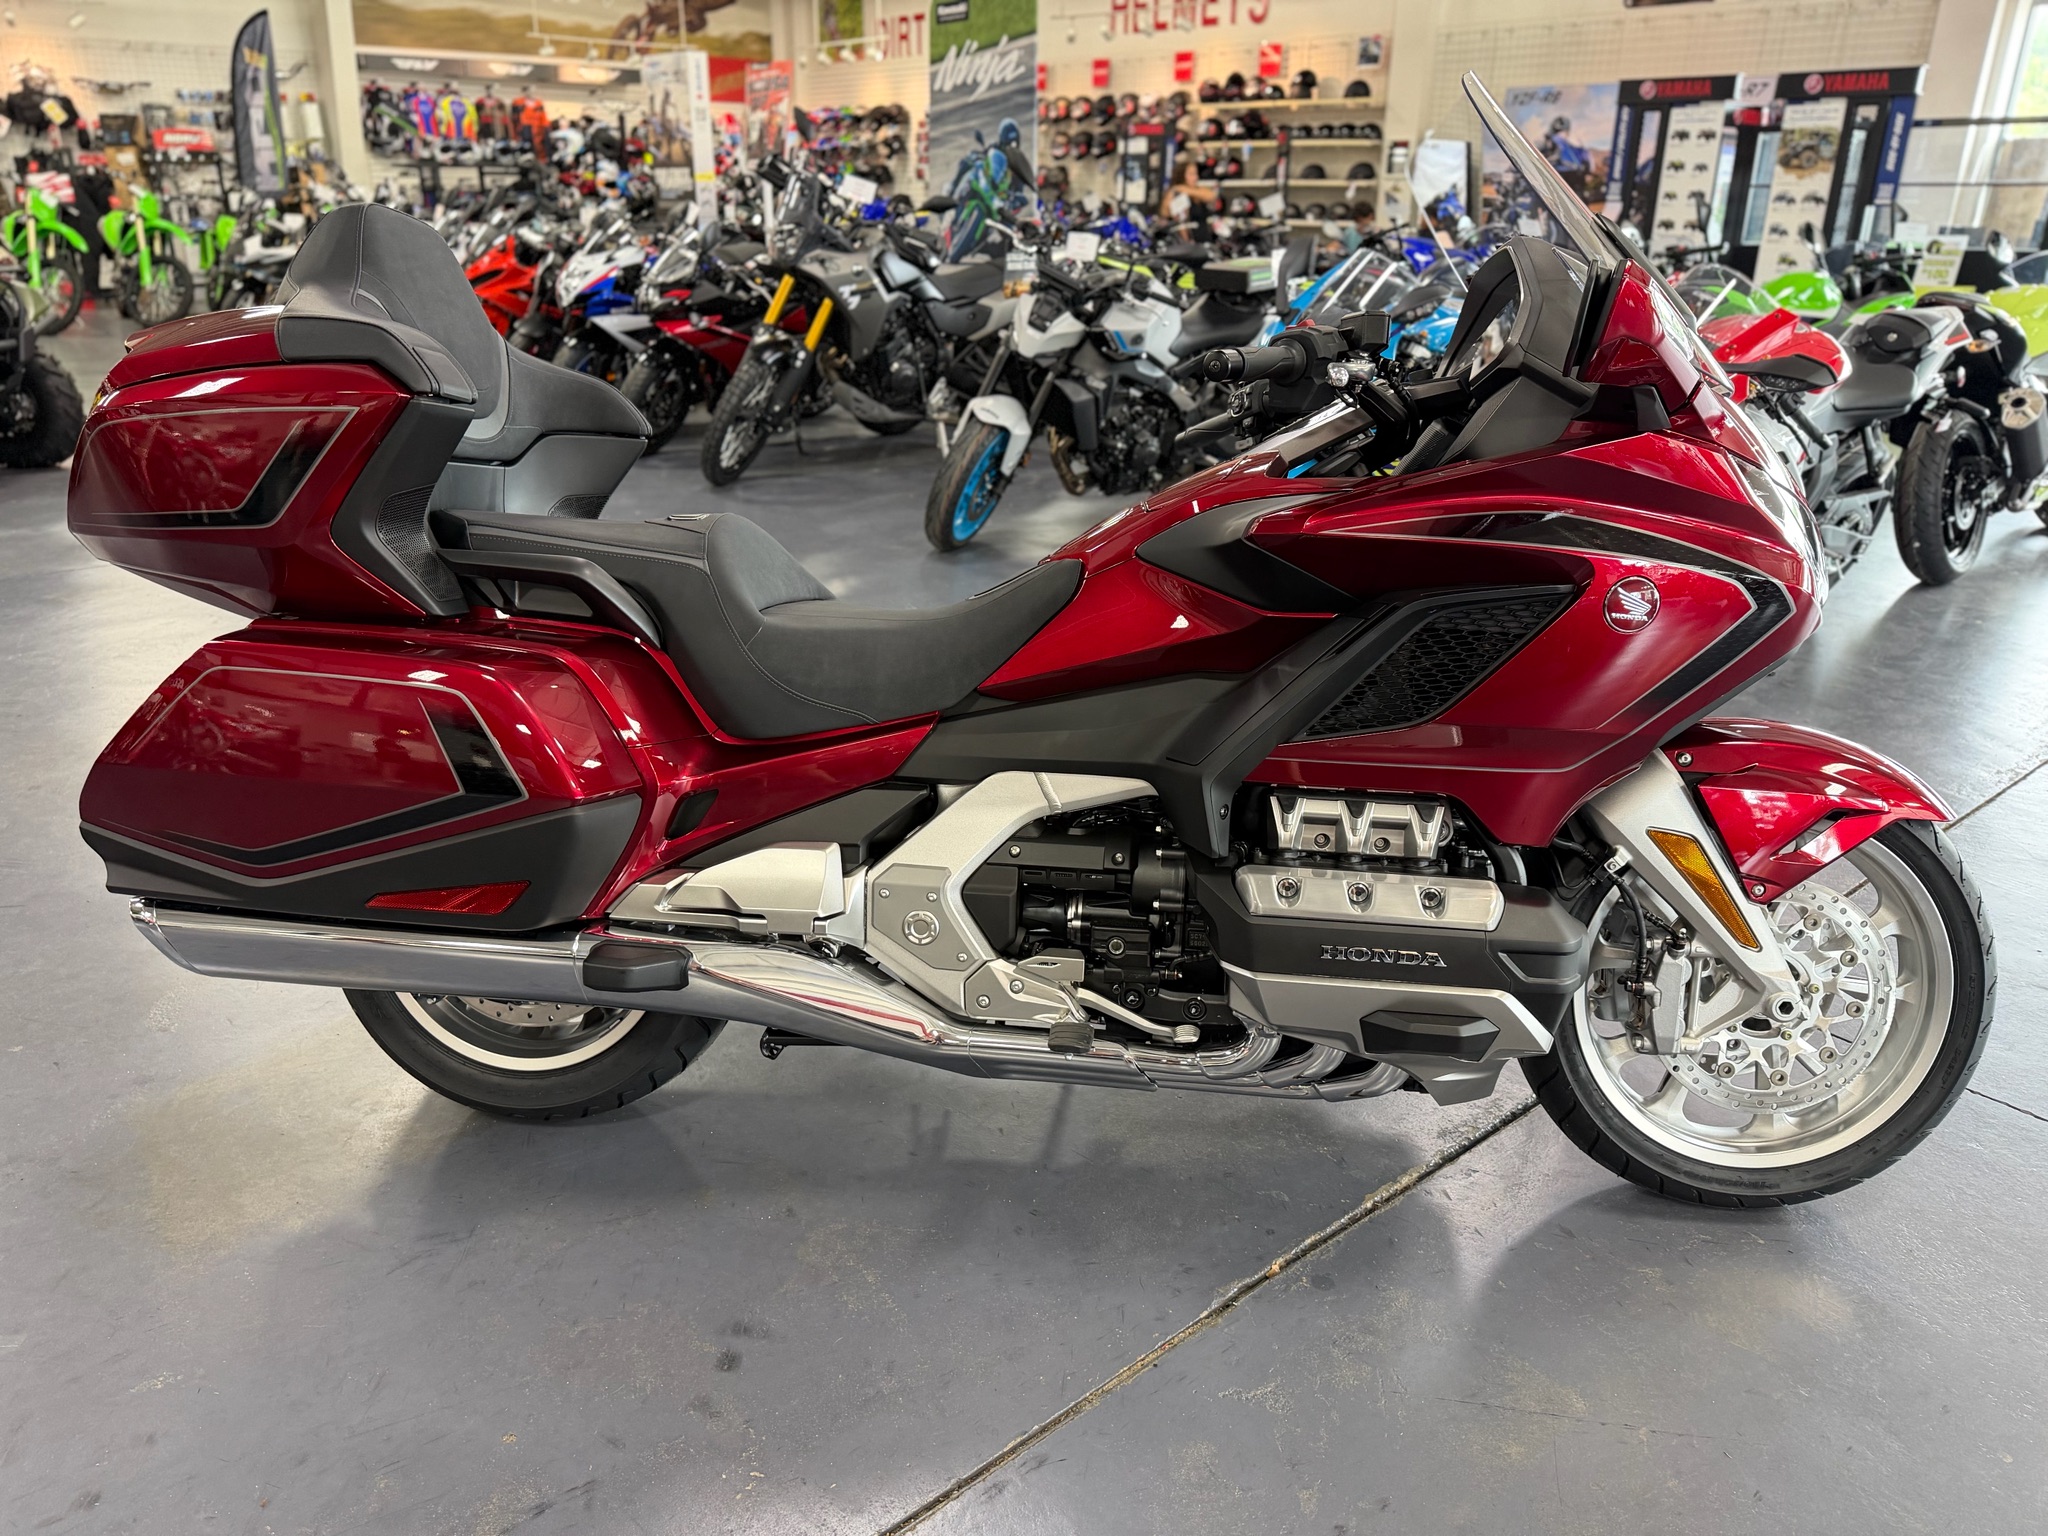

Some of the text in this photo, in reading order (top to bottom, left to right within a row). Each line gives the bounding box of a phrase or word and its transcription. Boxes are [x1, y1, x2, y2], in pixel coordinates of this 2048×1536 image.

[933, 34, 1026, 102] Ninja
[1656, 79, 1712, 98] YAMAHA
[1825, 71, 1889, 93] YAMAHA
[1611, 612, 1648, 621] HONDA
[1320, 944, 1448, 968] HONDA
